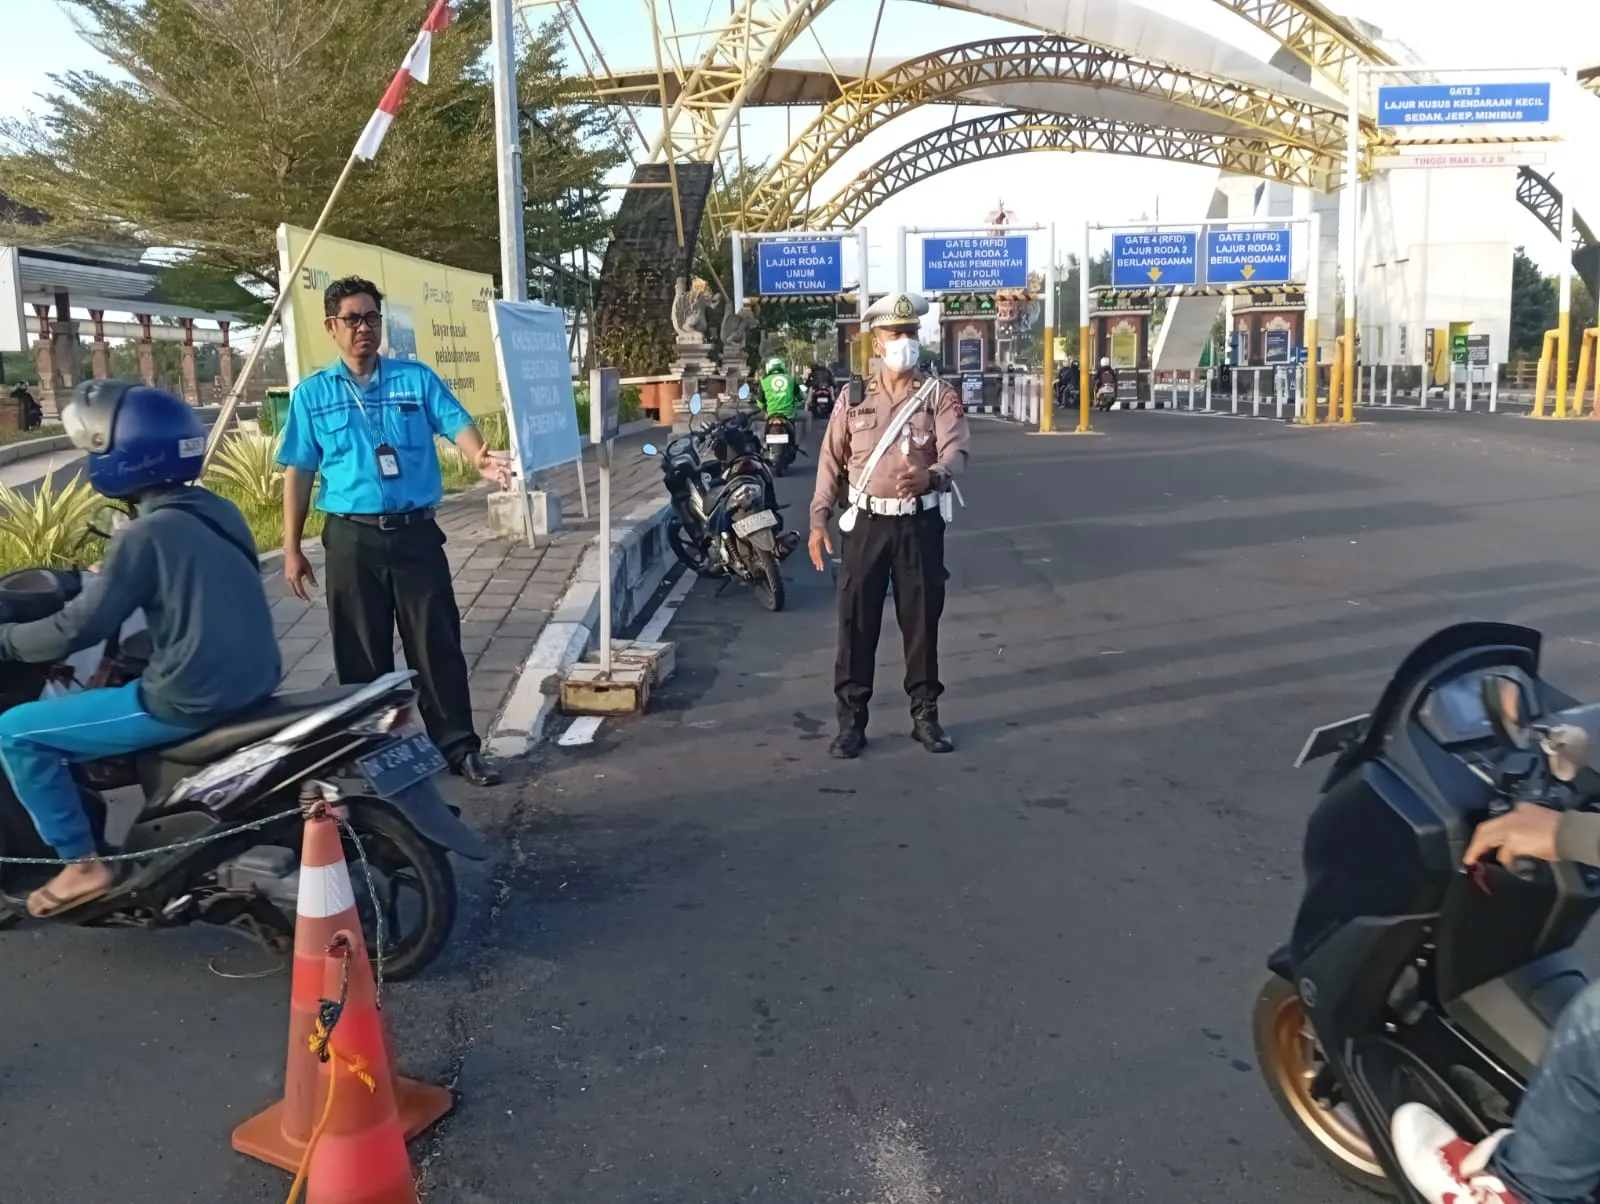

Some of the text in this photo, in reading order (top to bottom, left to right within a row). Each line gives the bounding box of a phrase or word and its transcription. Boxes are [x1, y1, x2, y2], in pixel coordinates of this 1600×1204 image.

[1449, 87, 1480, 96] GATE 2
[1384, 97, 1544, 110] LAJUR KUSUS KENDARAAN KECIL
[1404, 112, 1444, 122] SEDAN,
[1475, 110, 1522, 120] MINIBUS
[1414, 156, 1446, 166] TINGGI
[1125, 236, 1150, 244] GATE
[1159, 235, 1186, 244] (RFID)
[1218, 232, 1280, 242] GATE 3 (RFID)
[946, 238, 1007, 248] GATE 5 (RFID)
[783, 246, 816, 255] GATE 6
[942, 249, 1008, 259] LAJUR RODA 2
[1122, 246, 1188, 256] LAJUR RODA 2
[1216, 244, 1280, 254] LAJUR RODA 2
[766, 256, 833, 268] LAJUR RODA 2
[928, 258, 1022, 269] INSTANSI PEMERINTAH
[1117, 256, 1192, 267] BERLANGGANAN
[1210, 254, 1286, 264] BERLANGGANAN
[786, 269, 815, 278] UMUM
[952, 270, 966, 278] TNI
[972, 270, 1000, 278] POLRI
[775, 280, 826, 290] NON TUNAI
[948, 279, 1004, 288] PERBANKAN
[431, 319, 467, 341] bayar masuk
[435, 346, 480, 368] pelabuhan benoa
[363, 758, 385, 777] DK
